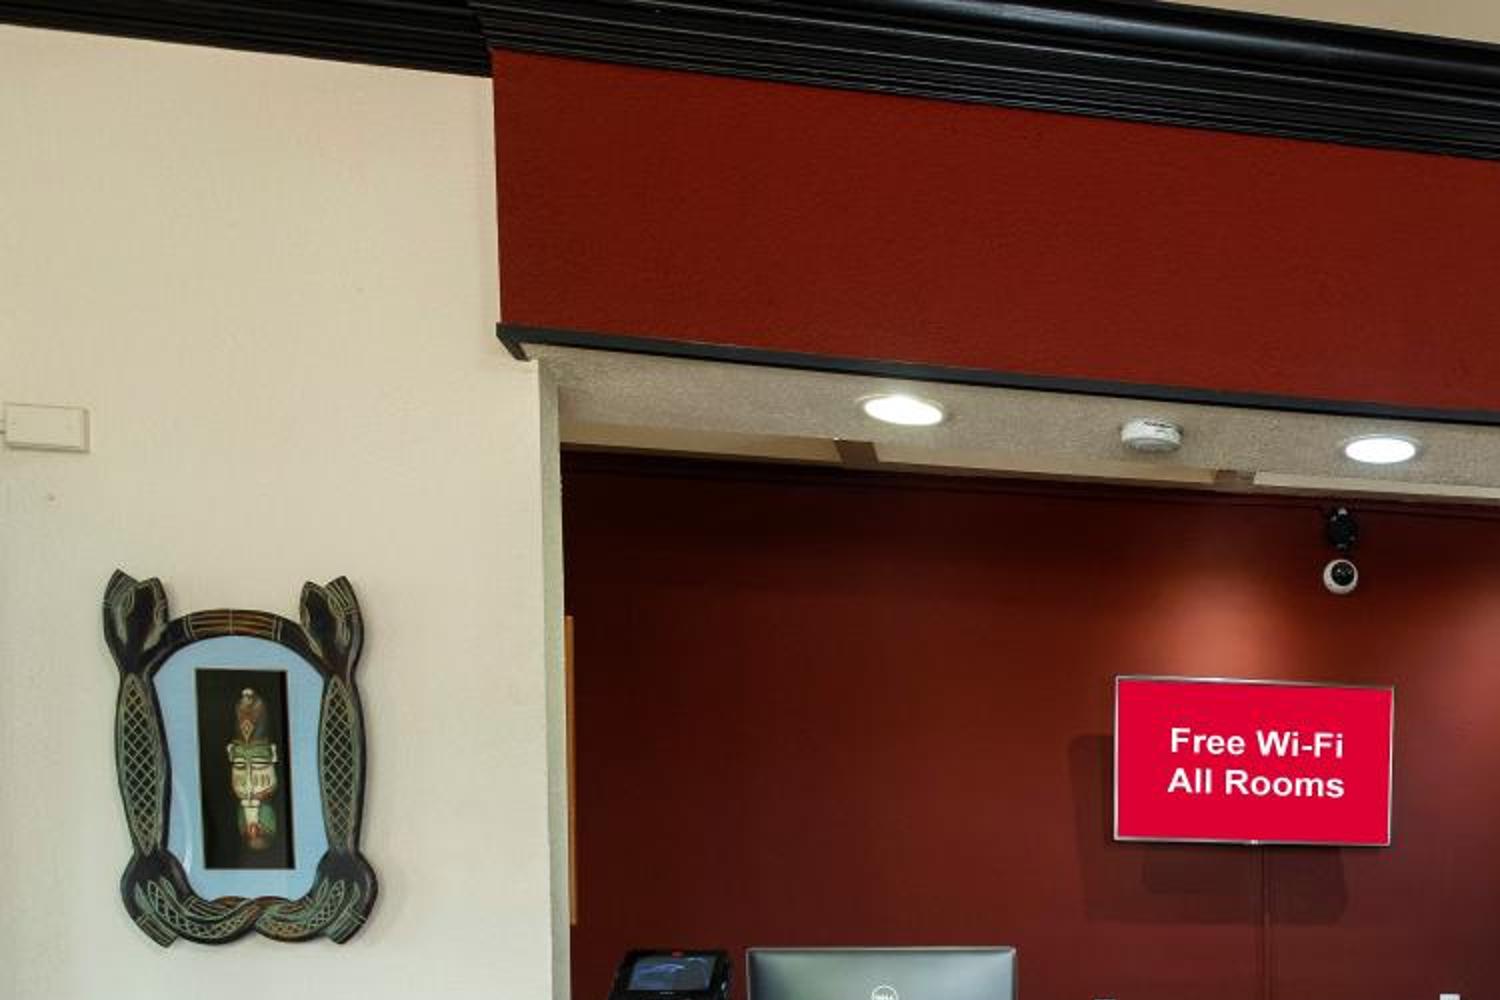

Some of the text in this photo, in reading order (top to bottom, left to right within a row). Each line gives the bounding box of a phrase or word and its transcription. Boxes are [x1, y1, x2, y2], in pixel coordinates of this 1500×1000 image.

[1170, 727, 1344, 759] Free Wi-Fi
[1167, 767, 1345, 799] All Rooms
